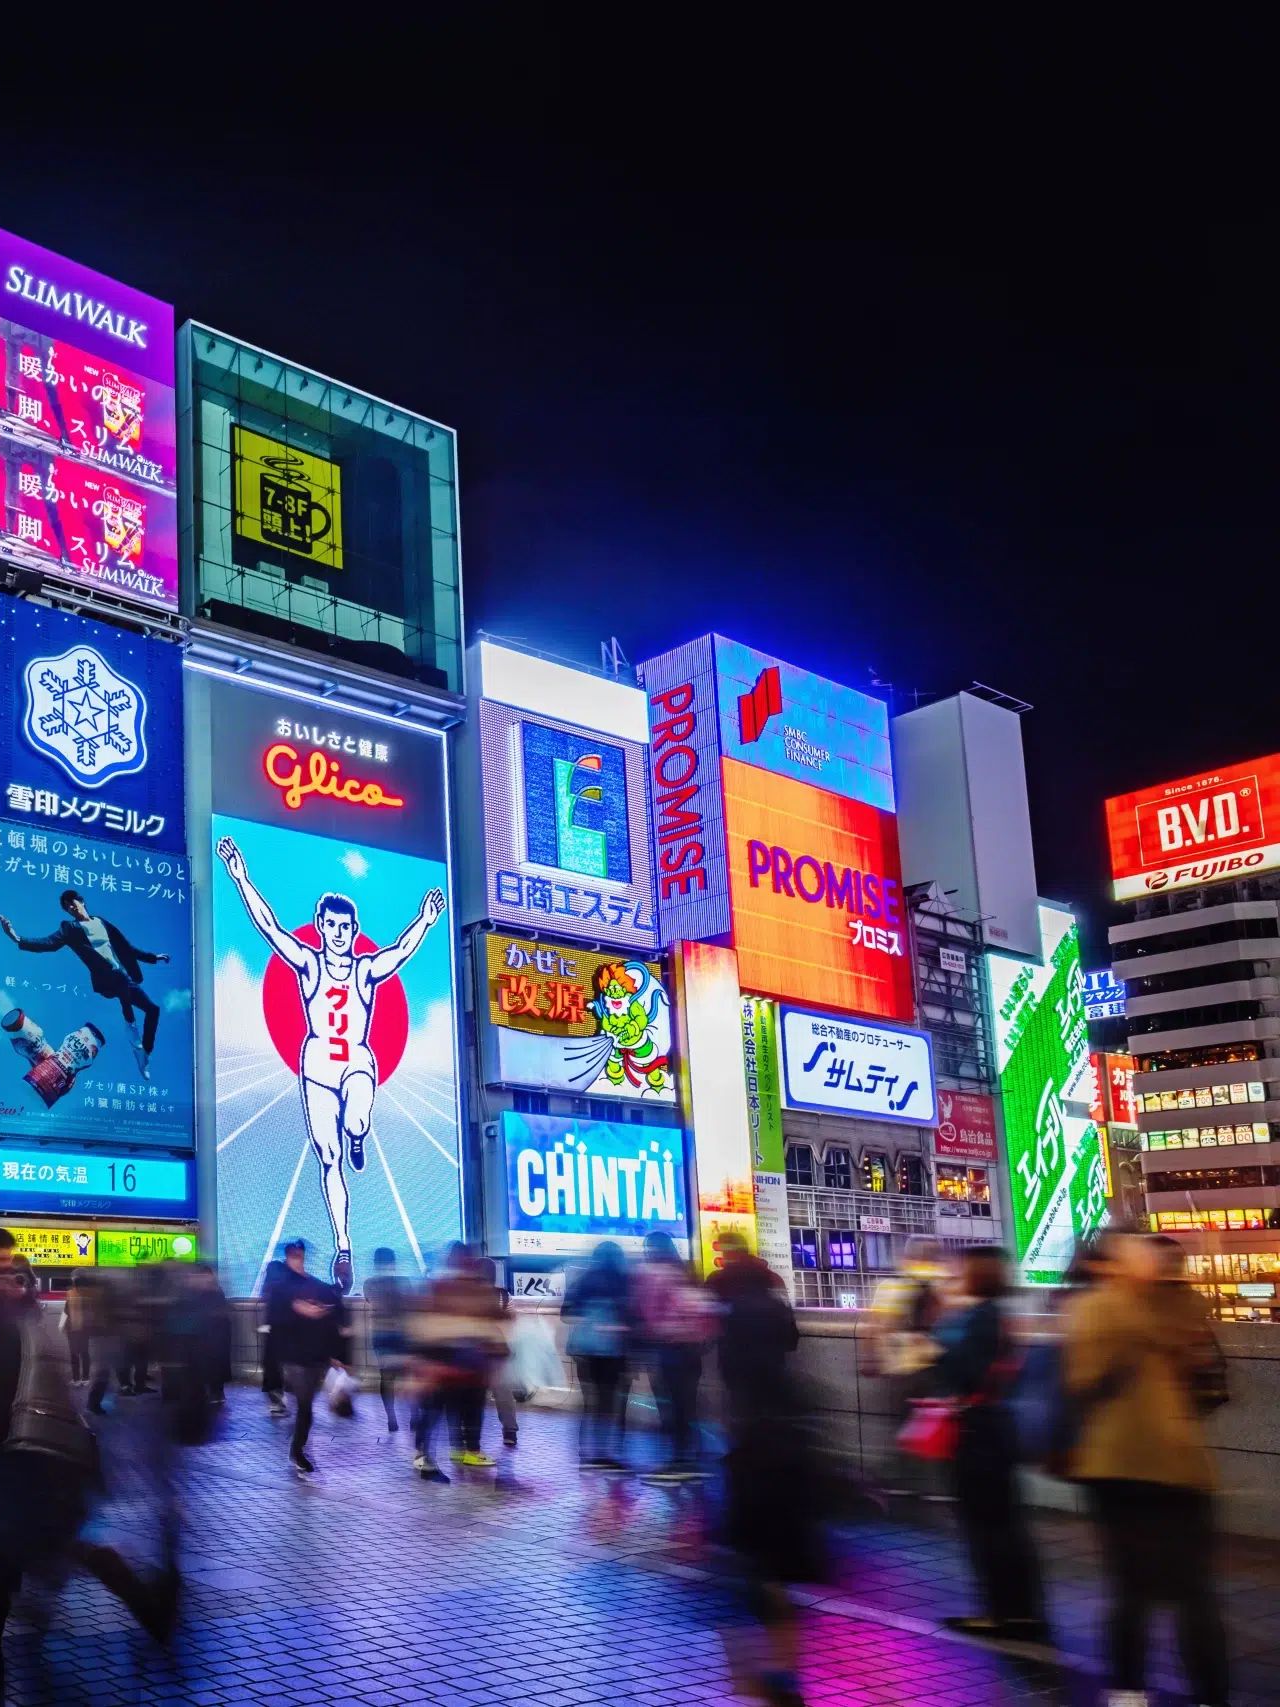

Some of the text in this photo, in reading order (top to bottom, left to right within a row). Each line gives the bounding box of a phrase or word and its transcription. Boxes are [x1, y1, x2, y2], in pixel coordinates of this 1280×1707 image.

[5, 266, 148, 349] SLIMWALK
[277, 719, 389, 763] おいしさと健康
[784, 723, 808, 743] SMBC
[784, 736, 831, 762] CONSUMER
[266, 745, 404, 809] Glico
[786, 748, 824, 772] FINANCE
[6, 783, 165, 837] 雪印メグミルク
[651, 683, 708, 900] PROMISE
[1164, 784, 1193, 797] Since
[1157, 791, 1251, 852] B.V.D.
[746, 839, 900, 925] PROMISE
[1174, 852, 1265, 883] FUJIBO
[495, 870, 656, 932] 日商エステム
[848, 919, 903, 957] プロミス
[506, 943, 578, 978] かぜに
[498, 974, 588, 1023] 改源
[324, 983, 349, 1062] グリコ
[811, 1022, 911, 1050] 総合不動産のプロデューサー
[741, 1000, 764, 1168] 株式会社日本リート
[824, 1058, 899, 1097] サムティ
[1016, 1077, 1067, 1222] エイブル
[2, 1161, 137, 1192] 現在の気温 16
[752, 1174, 781, 1185] NIHON
